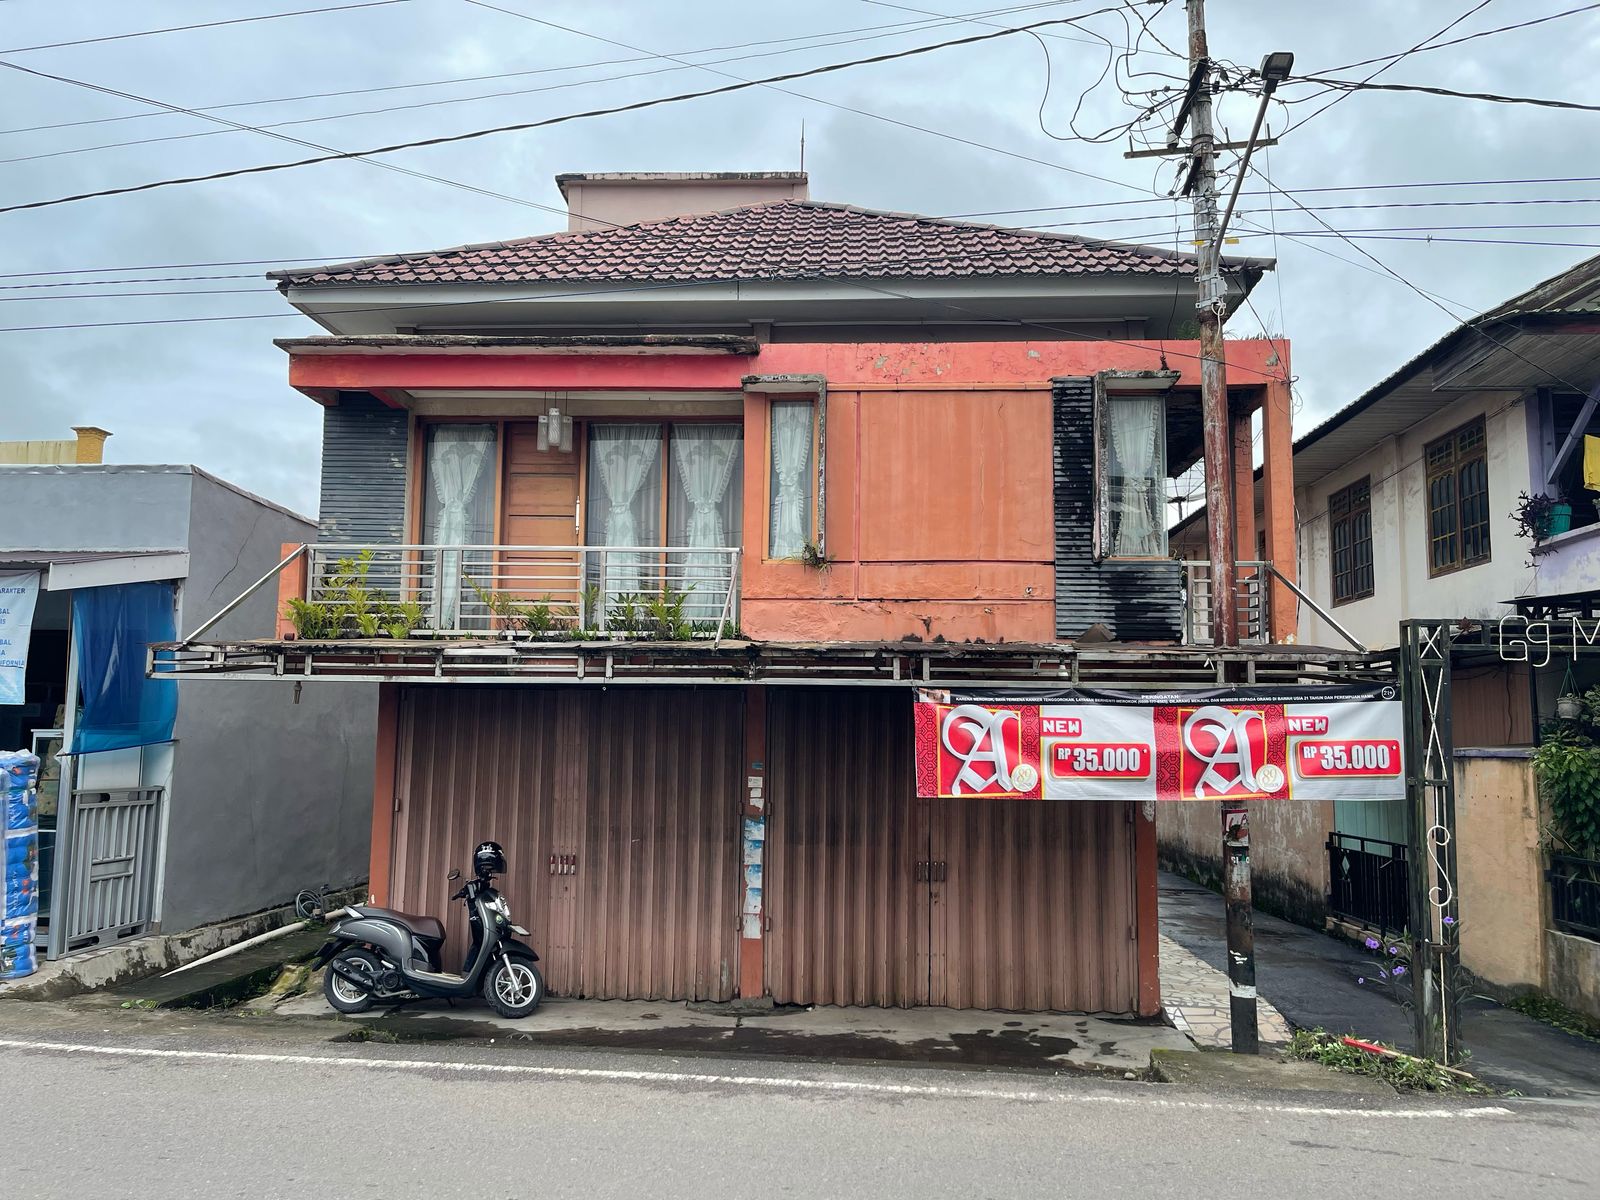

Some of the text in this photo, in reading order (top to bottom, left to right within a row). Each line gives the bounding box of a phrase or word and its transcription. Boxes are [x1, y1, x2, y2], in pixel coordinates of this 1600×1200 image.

[1499, 614, 1550, 667] Gg
[1042, 720, 1080, 734] NEW
[1288, 718, 1326, 732] NEW
[1058, 748, 1070, 760] RP
[1303, 746, 1317, 759] RP
